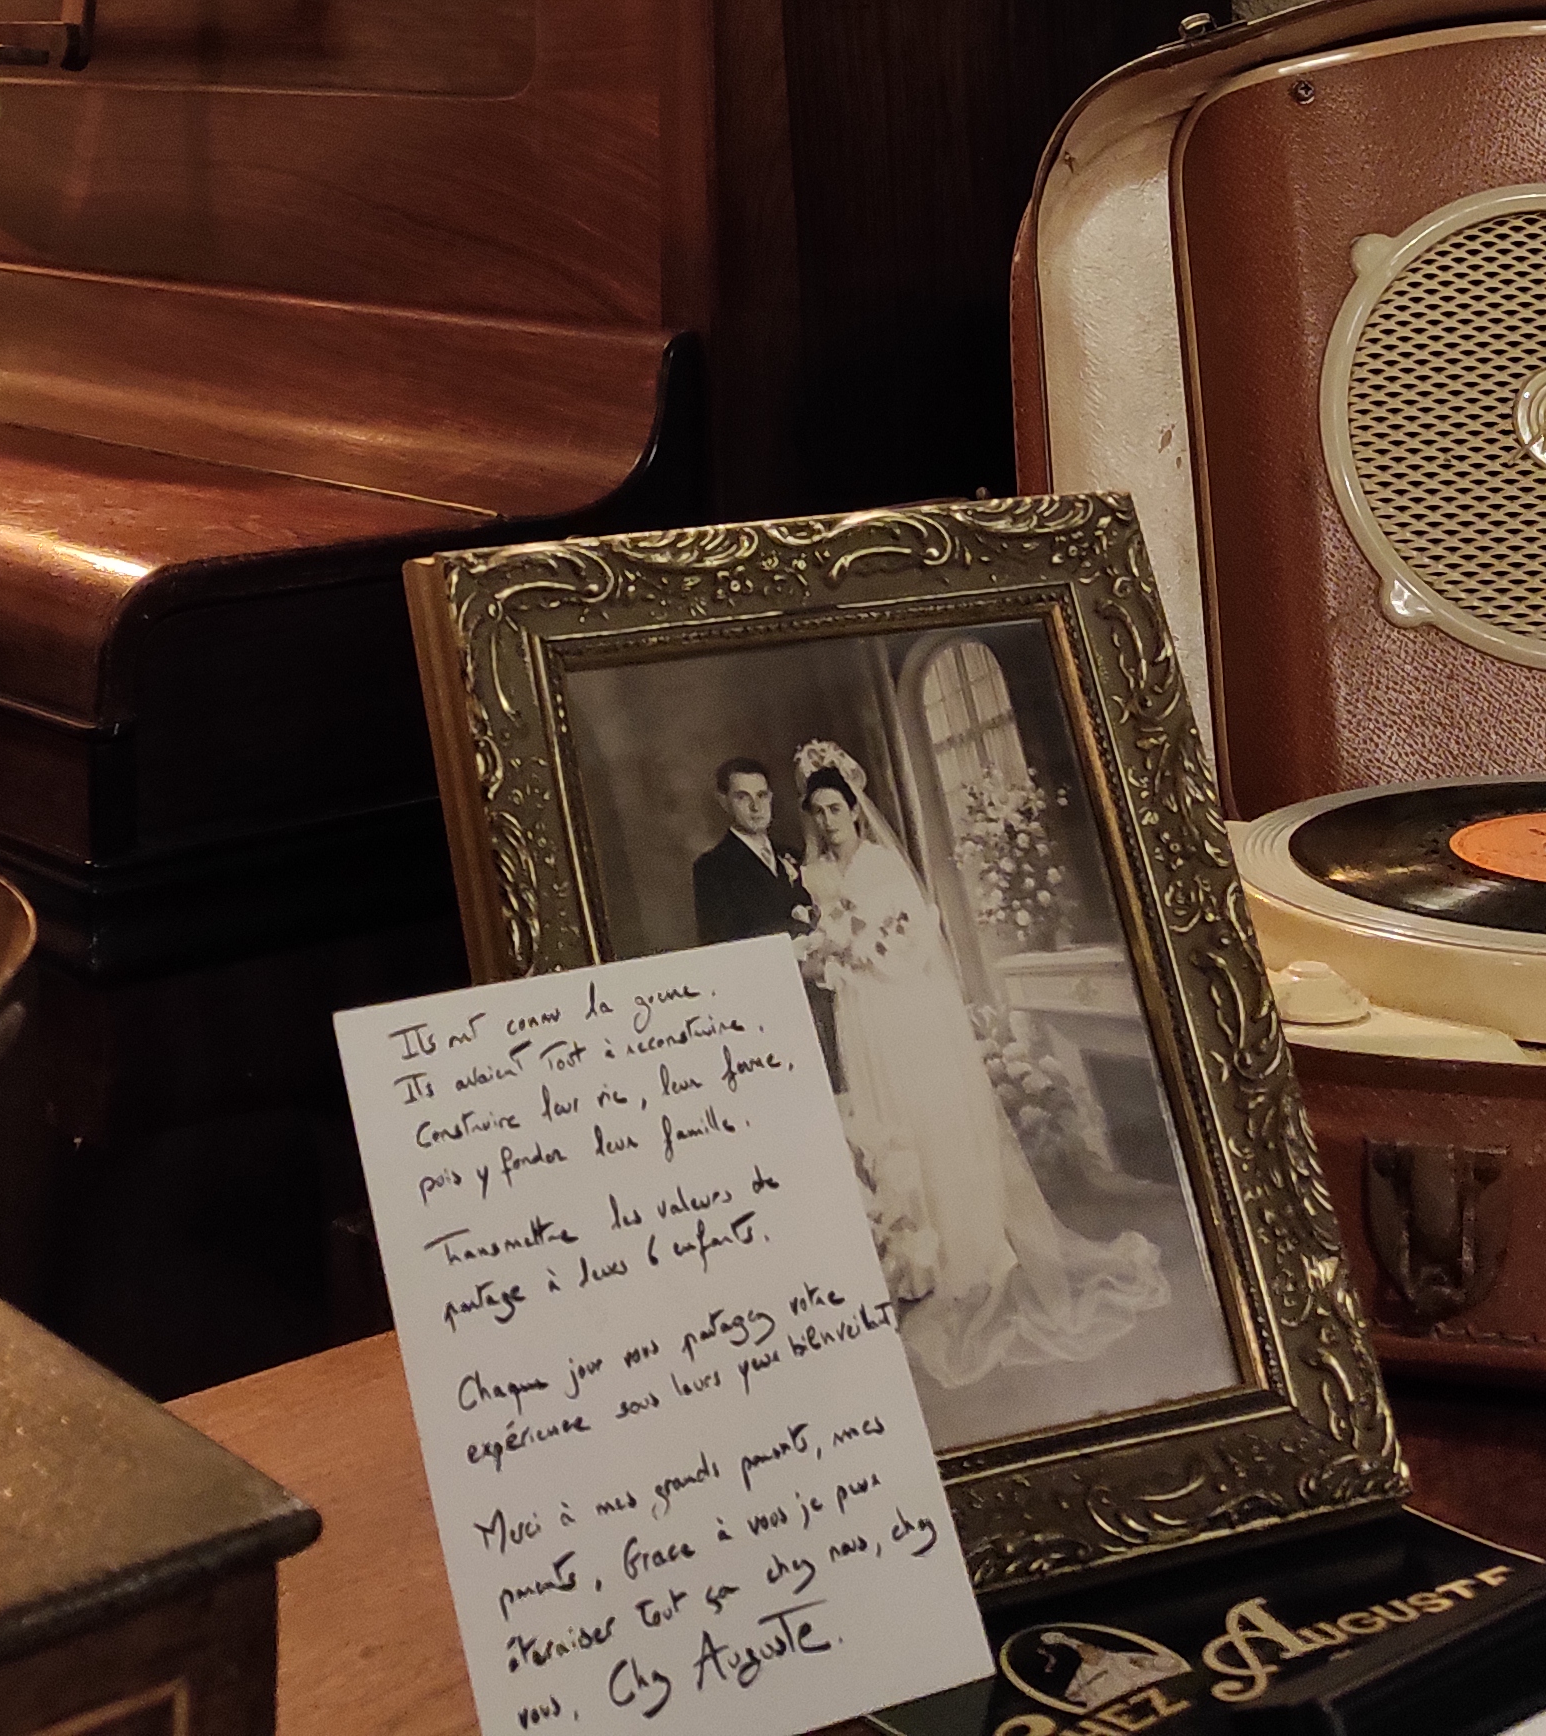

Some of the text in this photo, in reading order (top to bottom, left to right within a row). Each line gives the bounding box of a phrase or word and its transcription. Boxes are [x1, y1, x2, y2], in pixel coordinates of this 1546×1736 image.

[585, 980, 614, 1020] la
[659, 1063, 703, 1096] leur
[476, 1165, 489, 1200] y
[594, 1124, 639, 1157] leur
[657, 1185, 732, 1219] valeurs
[752, 1164, 780, 1194] de
[547, 1267, 561, 1292] à
[564, 1357, 603, 1399] jour
[467, 1420, 592, 1473] expérience
[561, 1501, 576, 1527] à
[717, 1517, 733, 1542] à
